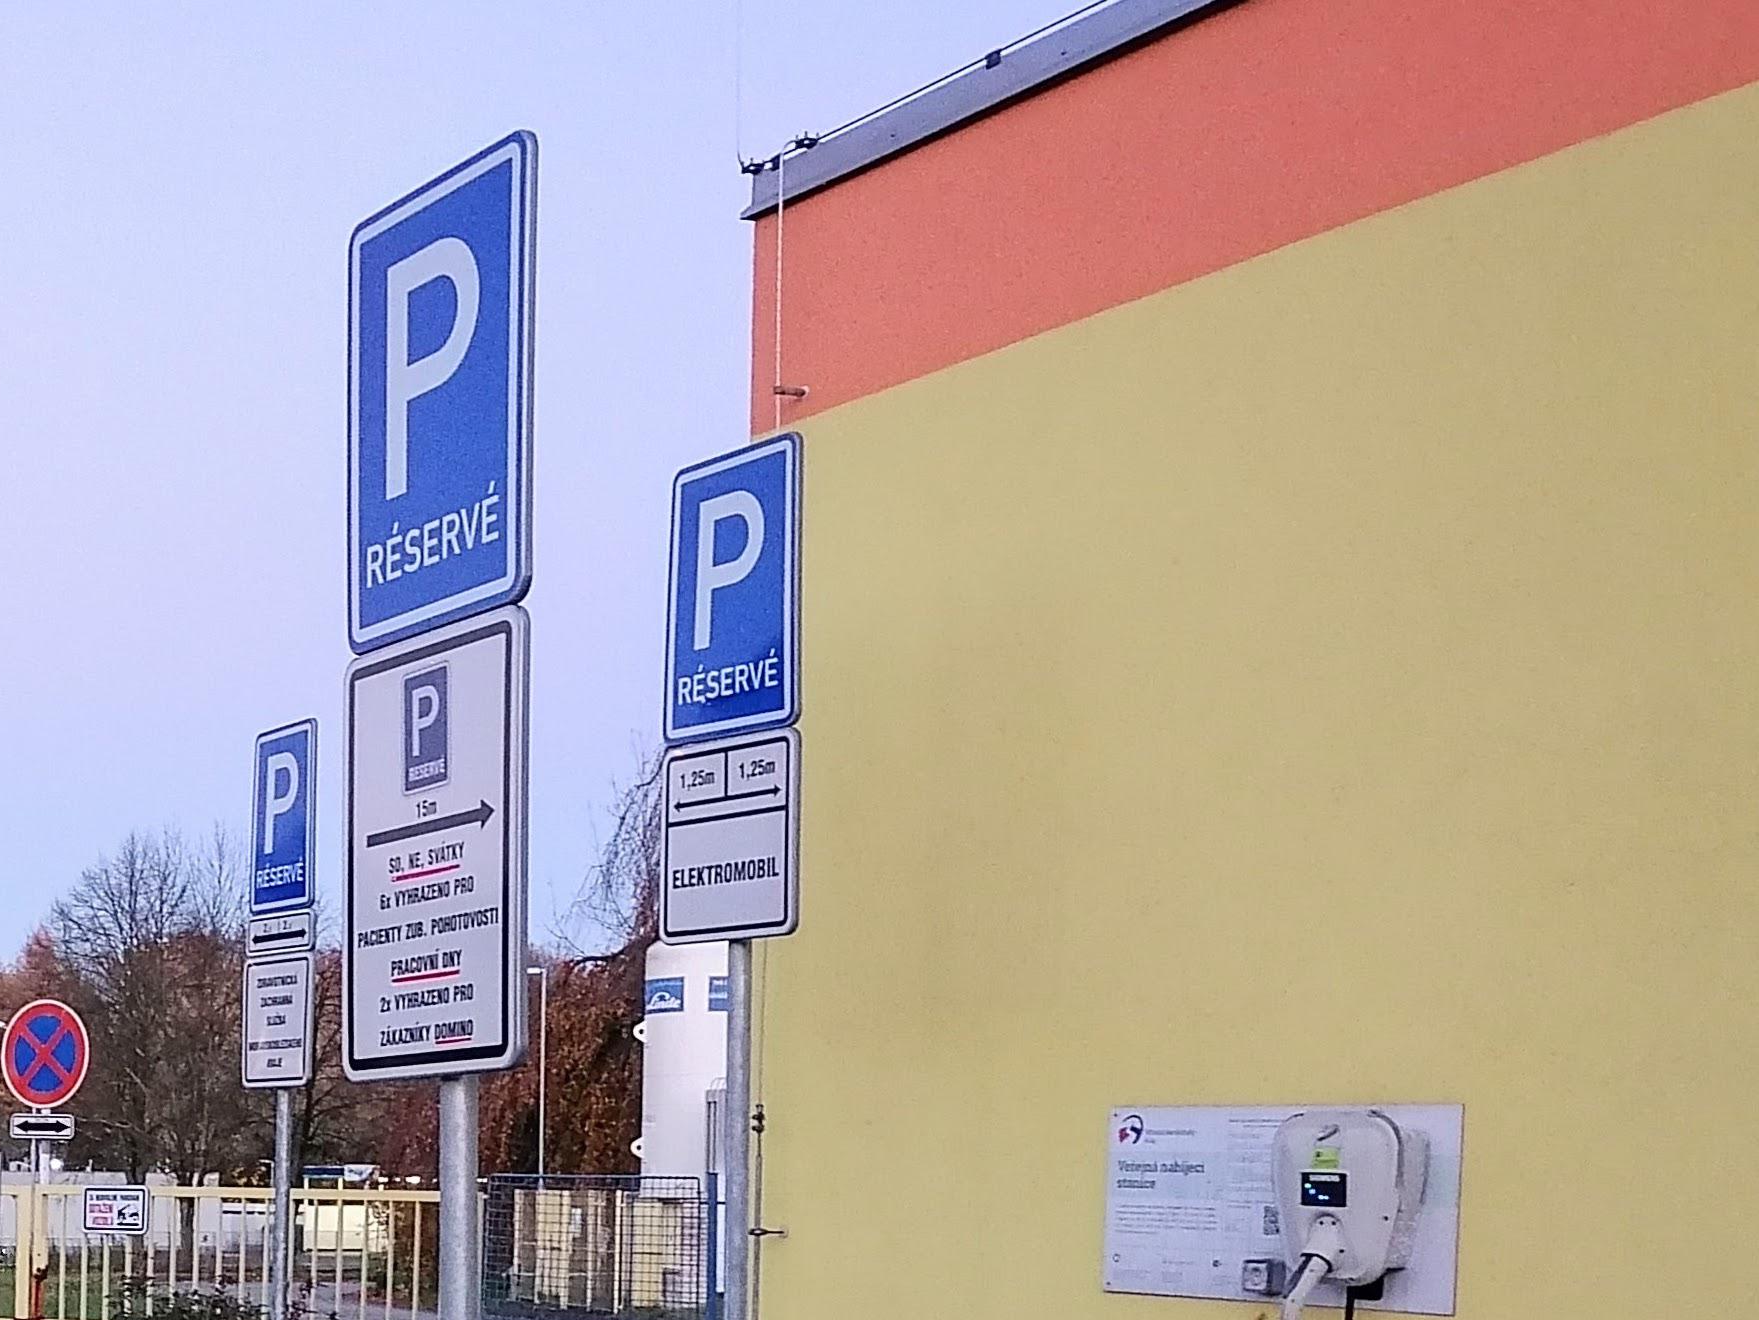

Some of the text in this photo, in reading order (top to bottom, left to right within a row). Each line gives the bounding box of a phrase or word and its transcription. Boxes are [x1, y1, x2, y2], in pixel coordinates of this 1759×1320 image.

[385, 237, 481, 501] P
[366, 480, 501, 588] RÉSERVÉ
[693, 490, 765, 651] P
[677, 648, 779, 705] RÉSERVÉ
[411, 685, 440, 757] P
[680, 769, 715, 791] 1,25m
[739, 759, 776, 781] 1,25m
[263, 752, 300, 855] P
[428, 841, 465, 866] SVÁTKY
[256, 857, 304, 889] RÉSERVÉ
[672, 856, 779, 889] ELEKTROMOBIL
[394, 881, 450, 907] VYHRAZENO
[454, 876, 474, 896] PRO
[358, 925, 402, 948] PACIENTY
[431, 907, 499, 935] POHOTOVOSTI
[391, 948, 463, 977] PRACOVNÍ DNY
[394, 987, 449, 1010] VYHRAZENO
[453, 983, 474, 1002] PRO
[380, 1019, 474, 1046] ZÁKAZNÍKY DOMINO
